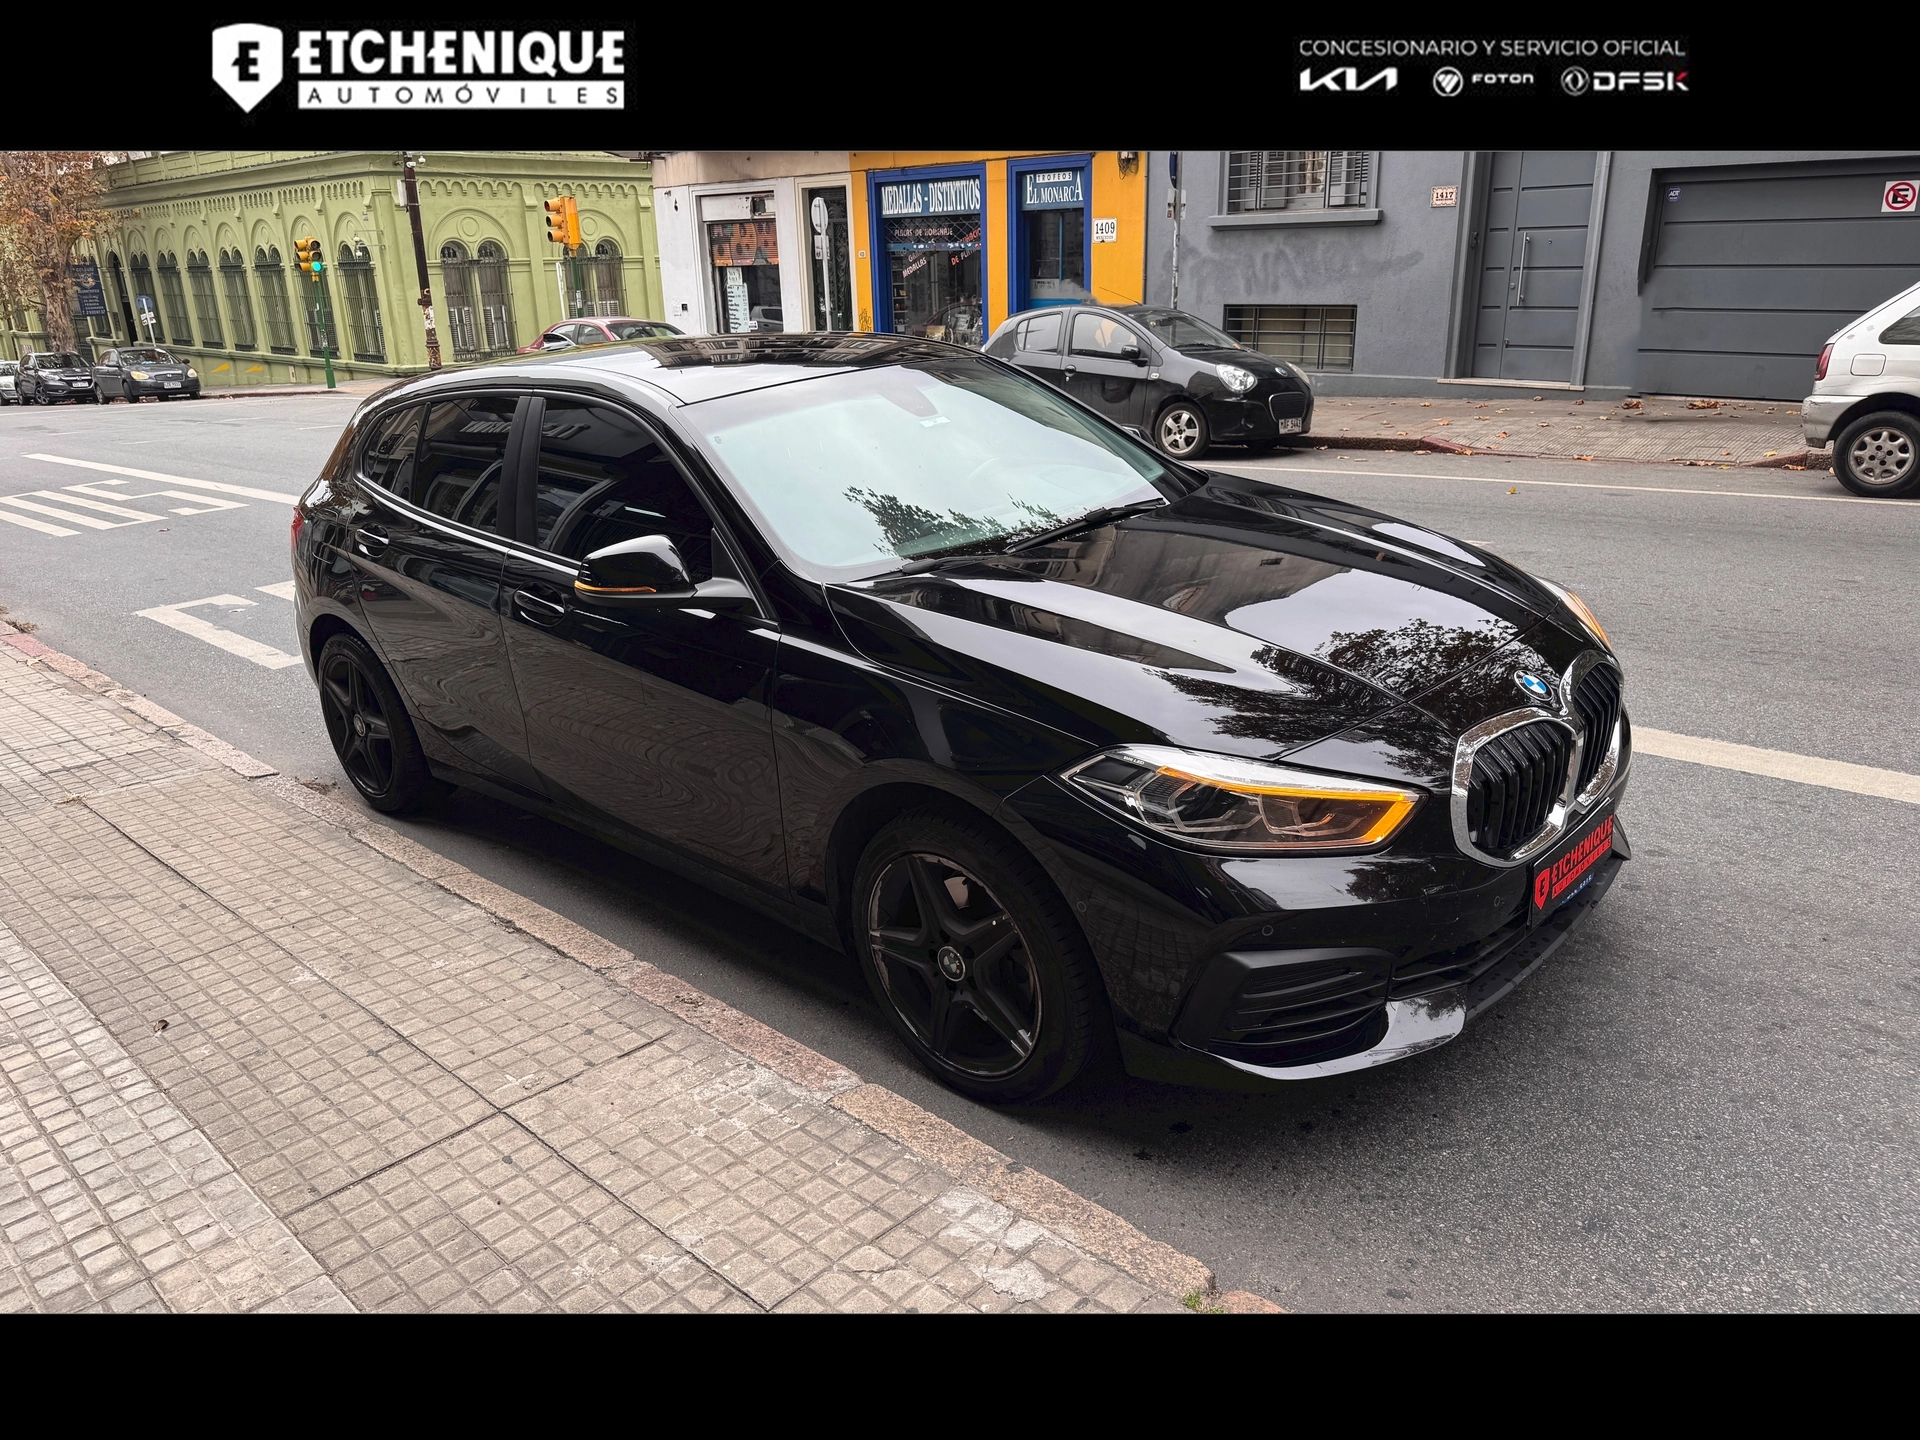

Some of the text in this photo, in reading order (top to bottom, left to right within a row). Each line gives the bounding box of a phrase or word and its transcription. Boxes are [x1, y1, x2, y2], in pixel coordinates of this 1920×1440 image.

[1026, 171, 1083, 204] EL MONARCA
[1038, 172, 1072, 181] TROFEOS
[881, 183, 922, 215] MEDALLAS
[928, 179, 981, 213] DISTINTIVOS
[1436, 191, 1454, 199] 1417
[1095, 222, 1115, 234] 1409
[1551, 814, 1613, 884] ETCHENIQUE
